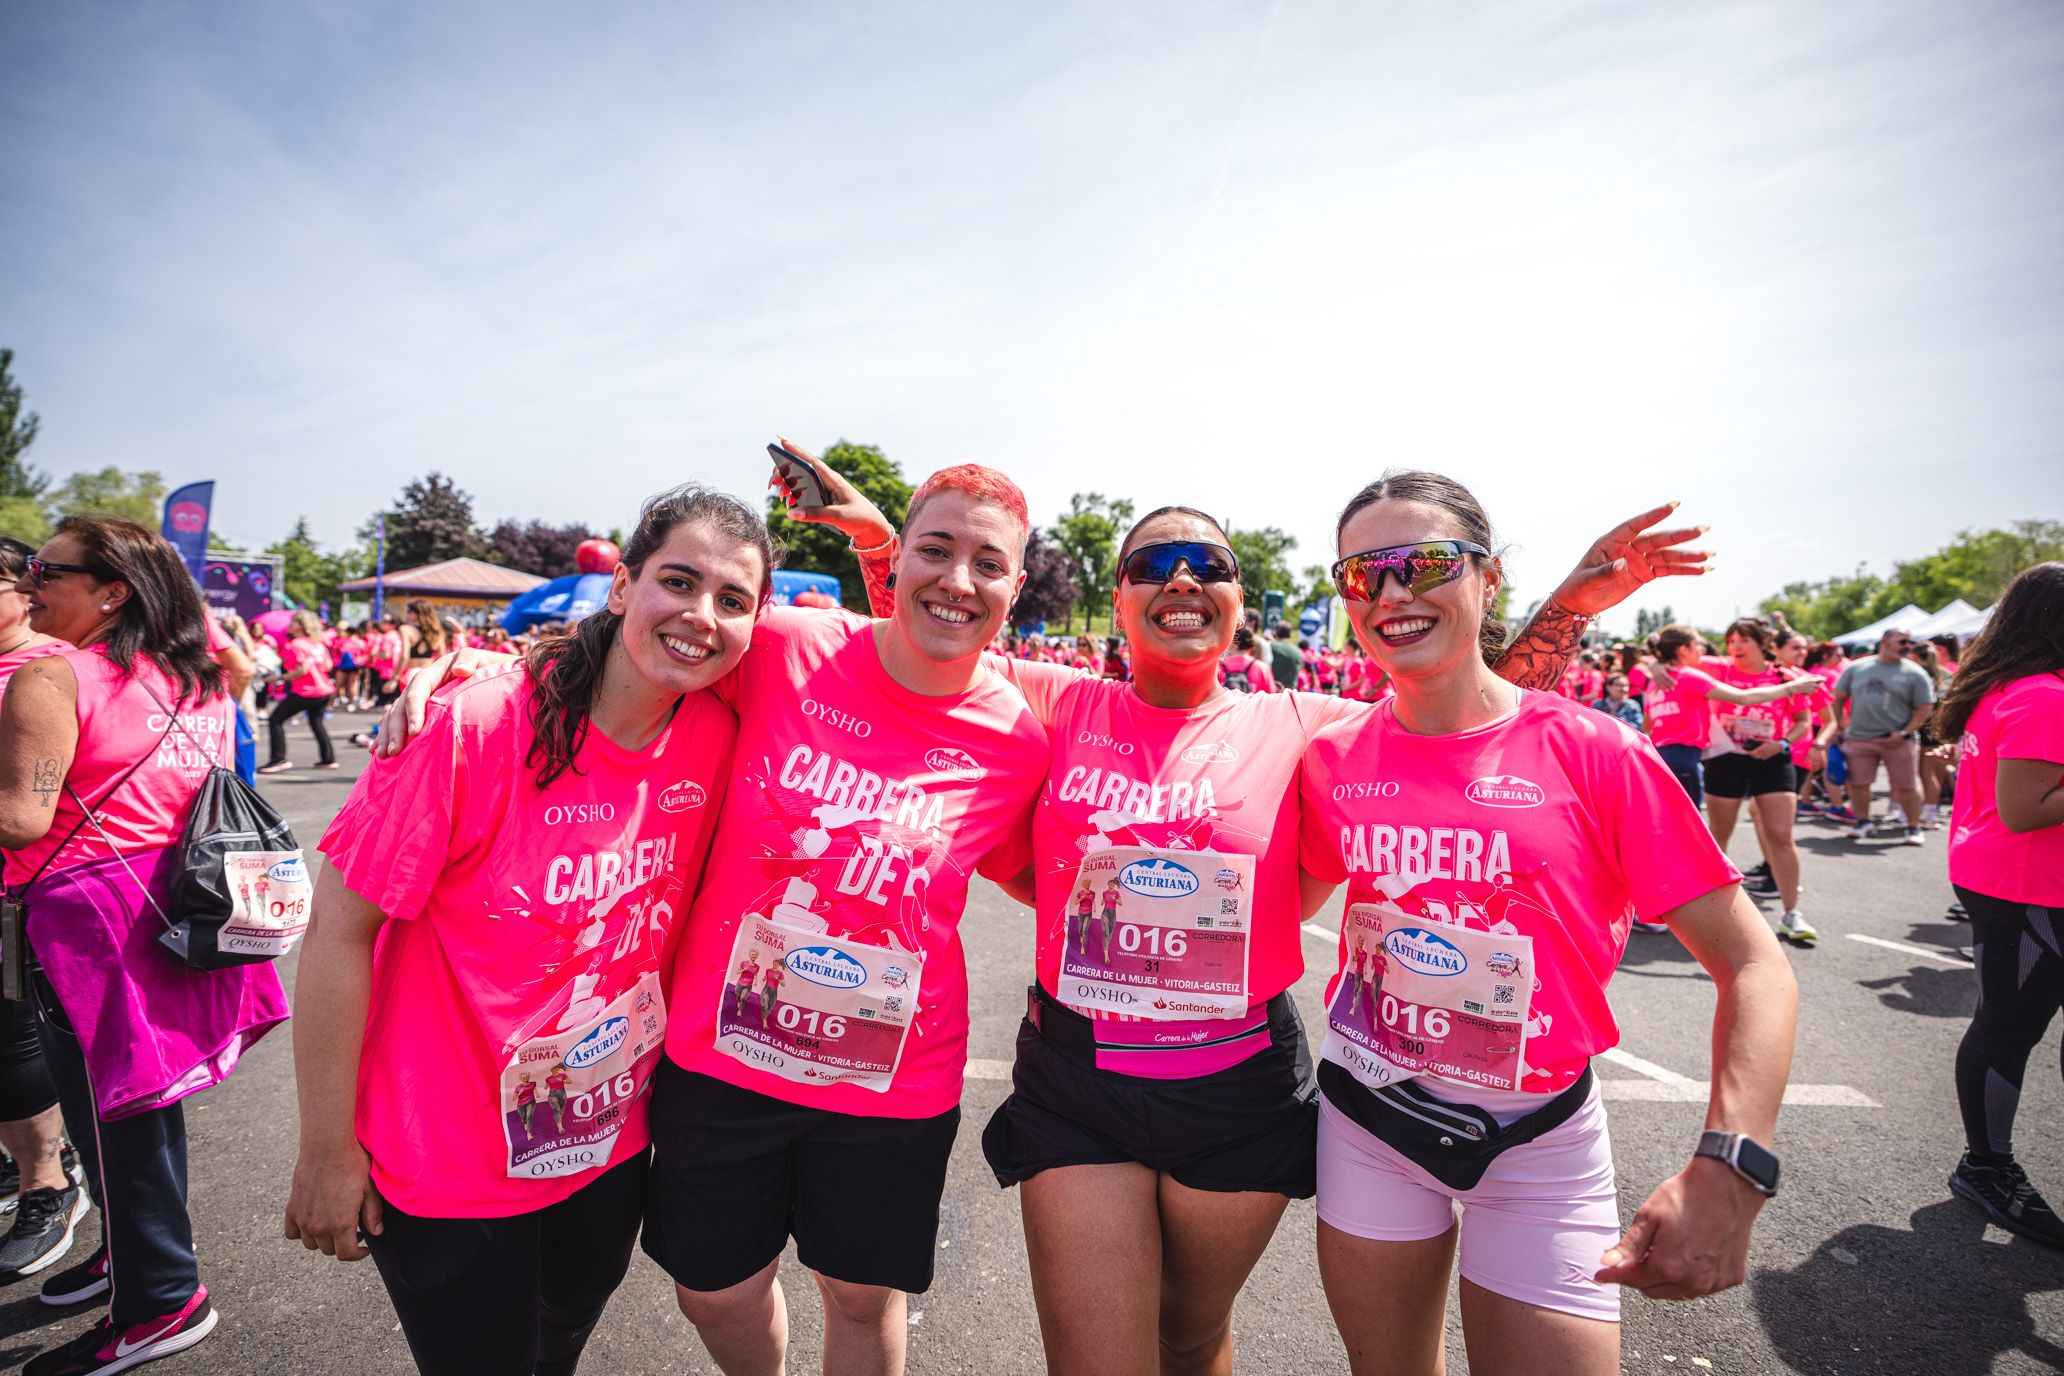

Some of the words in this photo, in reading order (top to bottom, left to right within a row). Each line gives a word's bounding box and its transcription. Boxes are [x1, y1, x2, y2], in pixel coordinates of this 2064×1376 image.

[801, 699, 871, 738] OYSHO
[161, 732, 188, 750] DE
[157, 750, 222, 769] MUJER
[779, 744, 945, 839] CARRERA
[1058, 764, 1219, 824] CARRERA
[1333, 781, 1400, 801] OYSHO
[1470, 784, 1539, 803] ASTURIANA
[544, 803, 615, 826] OYSHO
[1340, 823, 1514, 885] CARRERA
[239, 862, 267, 870] SUMA
[543, 832, 677, 906] CARRERA
[1083, 861, 1117, 873] SUMA
[1124, 869, 1193, 891] ASTURIANA
[270, 898, 304, 918] 016
[1355, 916, 1383, 934] SUMA
[229, 938, 271, 949] OYSHO
[754, 931, 784, 952] SUMA
[1118, 924, 1188, 957] 016
[1390, 936, 1459, 972] ASTURIANA
[790, 953, 860, 984] ASTURIANA
[1144, 960, 1160, 973] 31
[1066, 963, 1101, 978] CARRERA
[1102, 971, 1114, 980] DE
[1115, 972, 1126, 982] LA
[1128, 974, 1158, 986] MUJER
[1164, 978, 1240, 993] VITORIA-GASTEIZ
[1077, 984, 1133, 1005] OYSHO
[1168, 1001, 1225, 1014] Santander
[1381, 995, 1451, 1038] 016
[777, 1004, 847, 1038] 016
[723, 1024, 759, 1039] CARRERA
[760, 1033, 771, 1044] DE
[772, 1039, 782, 1049] LA
[783, 1044, 812, 1059] MUJER
[818, 1054, 891, 1072] VITORIA-GASTEIZ
[732, 1040, 785, 1068] OYSHO
[796, 1036, 820, 1050] 694
[1331, 1020, 1369, 1046] CARRERA
[1369, 1040, 1379, 1051] DE
[1380, 1046, 1388, 1056] LA
[1387, 1052, 1417, 1069] MUJER
[1398, 1038, 1425, 1055] 300
[520, 1050, 560, 1064] SUMA
[1342, 1045, 1390, 1083] OYSHO
[818, 1071, 871, 1081] Santander
[572, 1070, 634, 1118] 016
[596, 1106, 619, 1126] 696
[515, 1141, 558, 1163] CARRERA
[559, 1137, 572, 1147] DE
[574, 1135, 586, 1144] LA
[588, 1123, 616, 1143] MUJER
[531, 1150, 594, 1176] OYSHO
